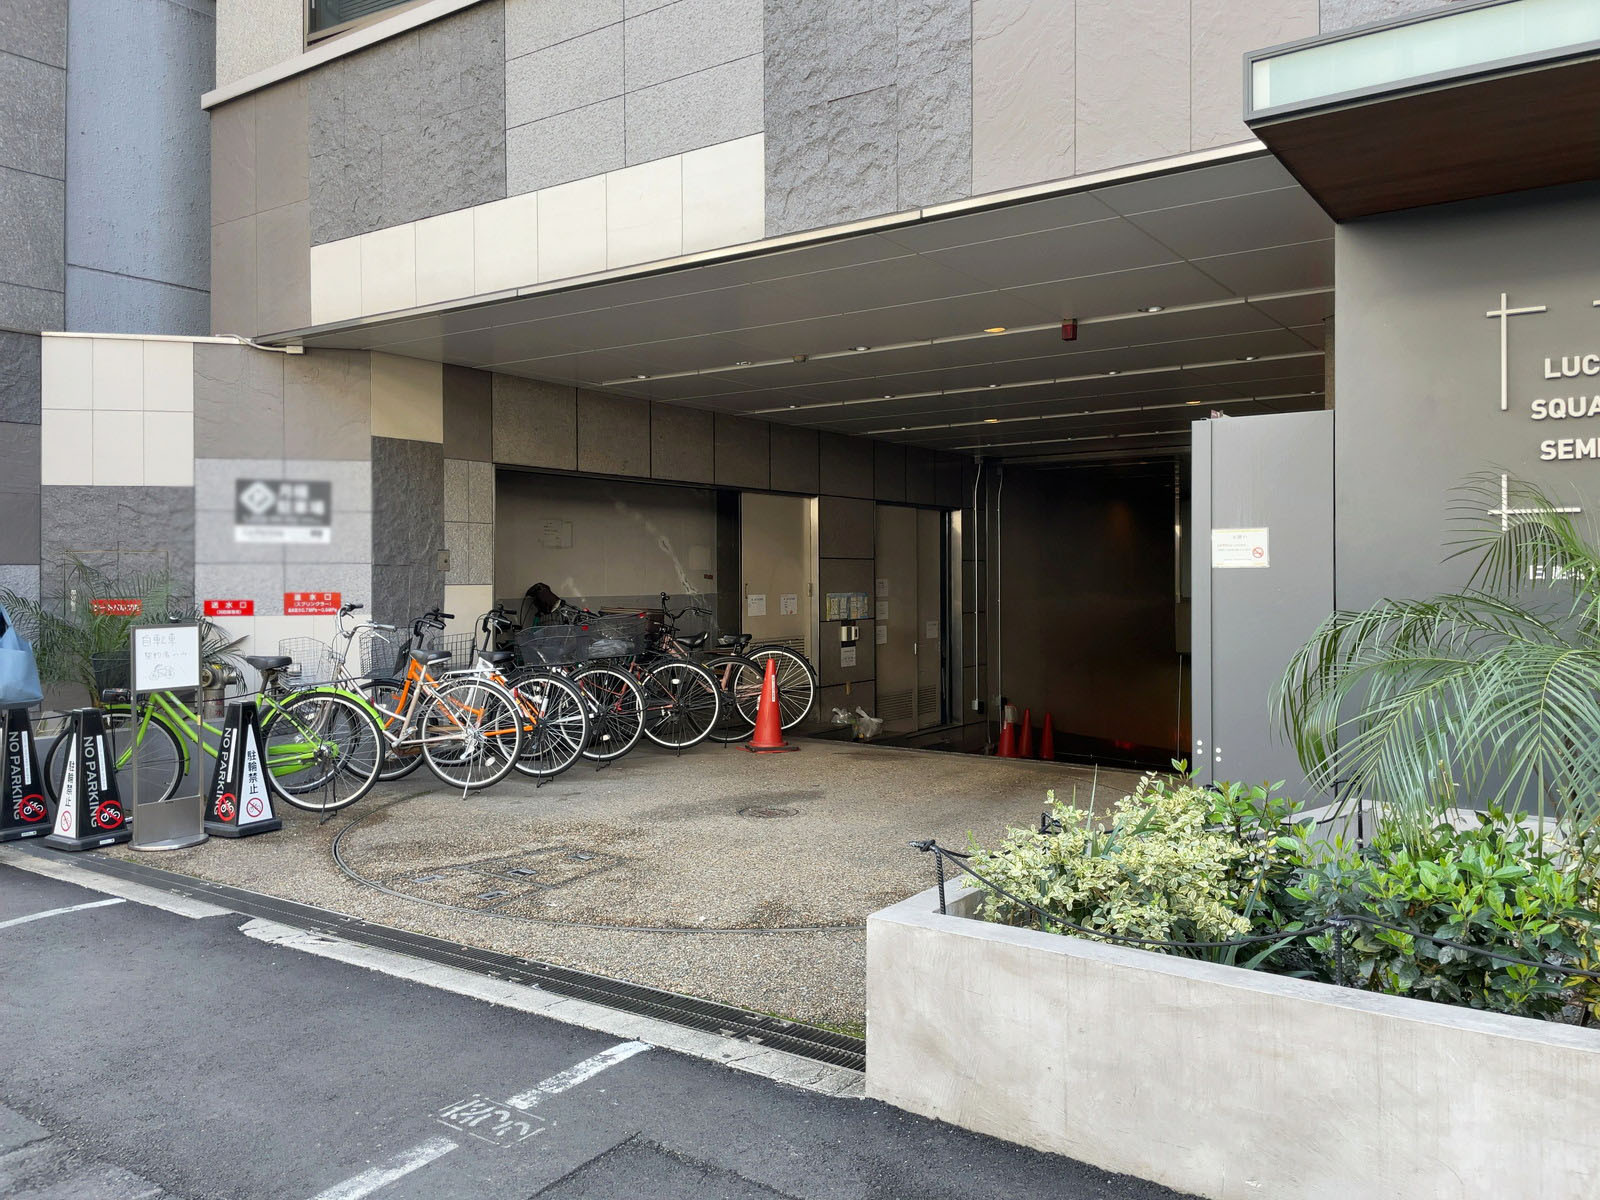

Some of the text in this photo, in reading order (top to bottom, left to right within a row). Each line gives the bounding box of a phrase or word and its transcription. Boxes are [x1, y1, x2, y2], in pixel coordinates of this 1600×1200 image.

[1544, 354, 1600, 379] LUC
[1531, 395, 1600, 420] SQUA
[223, 727, 232, 748] NO
[9, 731, 23, 820] NO PARKING
[84, 736, 99, 828] NO PARKING
[214, 751, 229, 815] PARKING
[247, 750, 259, 794] 駐輪禁止
